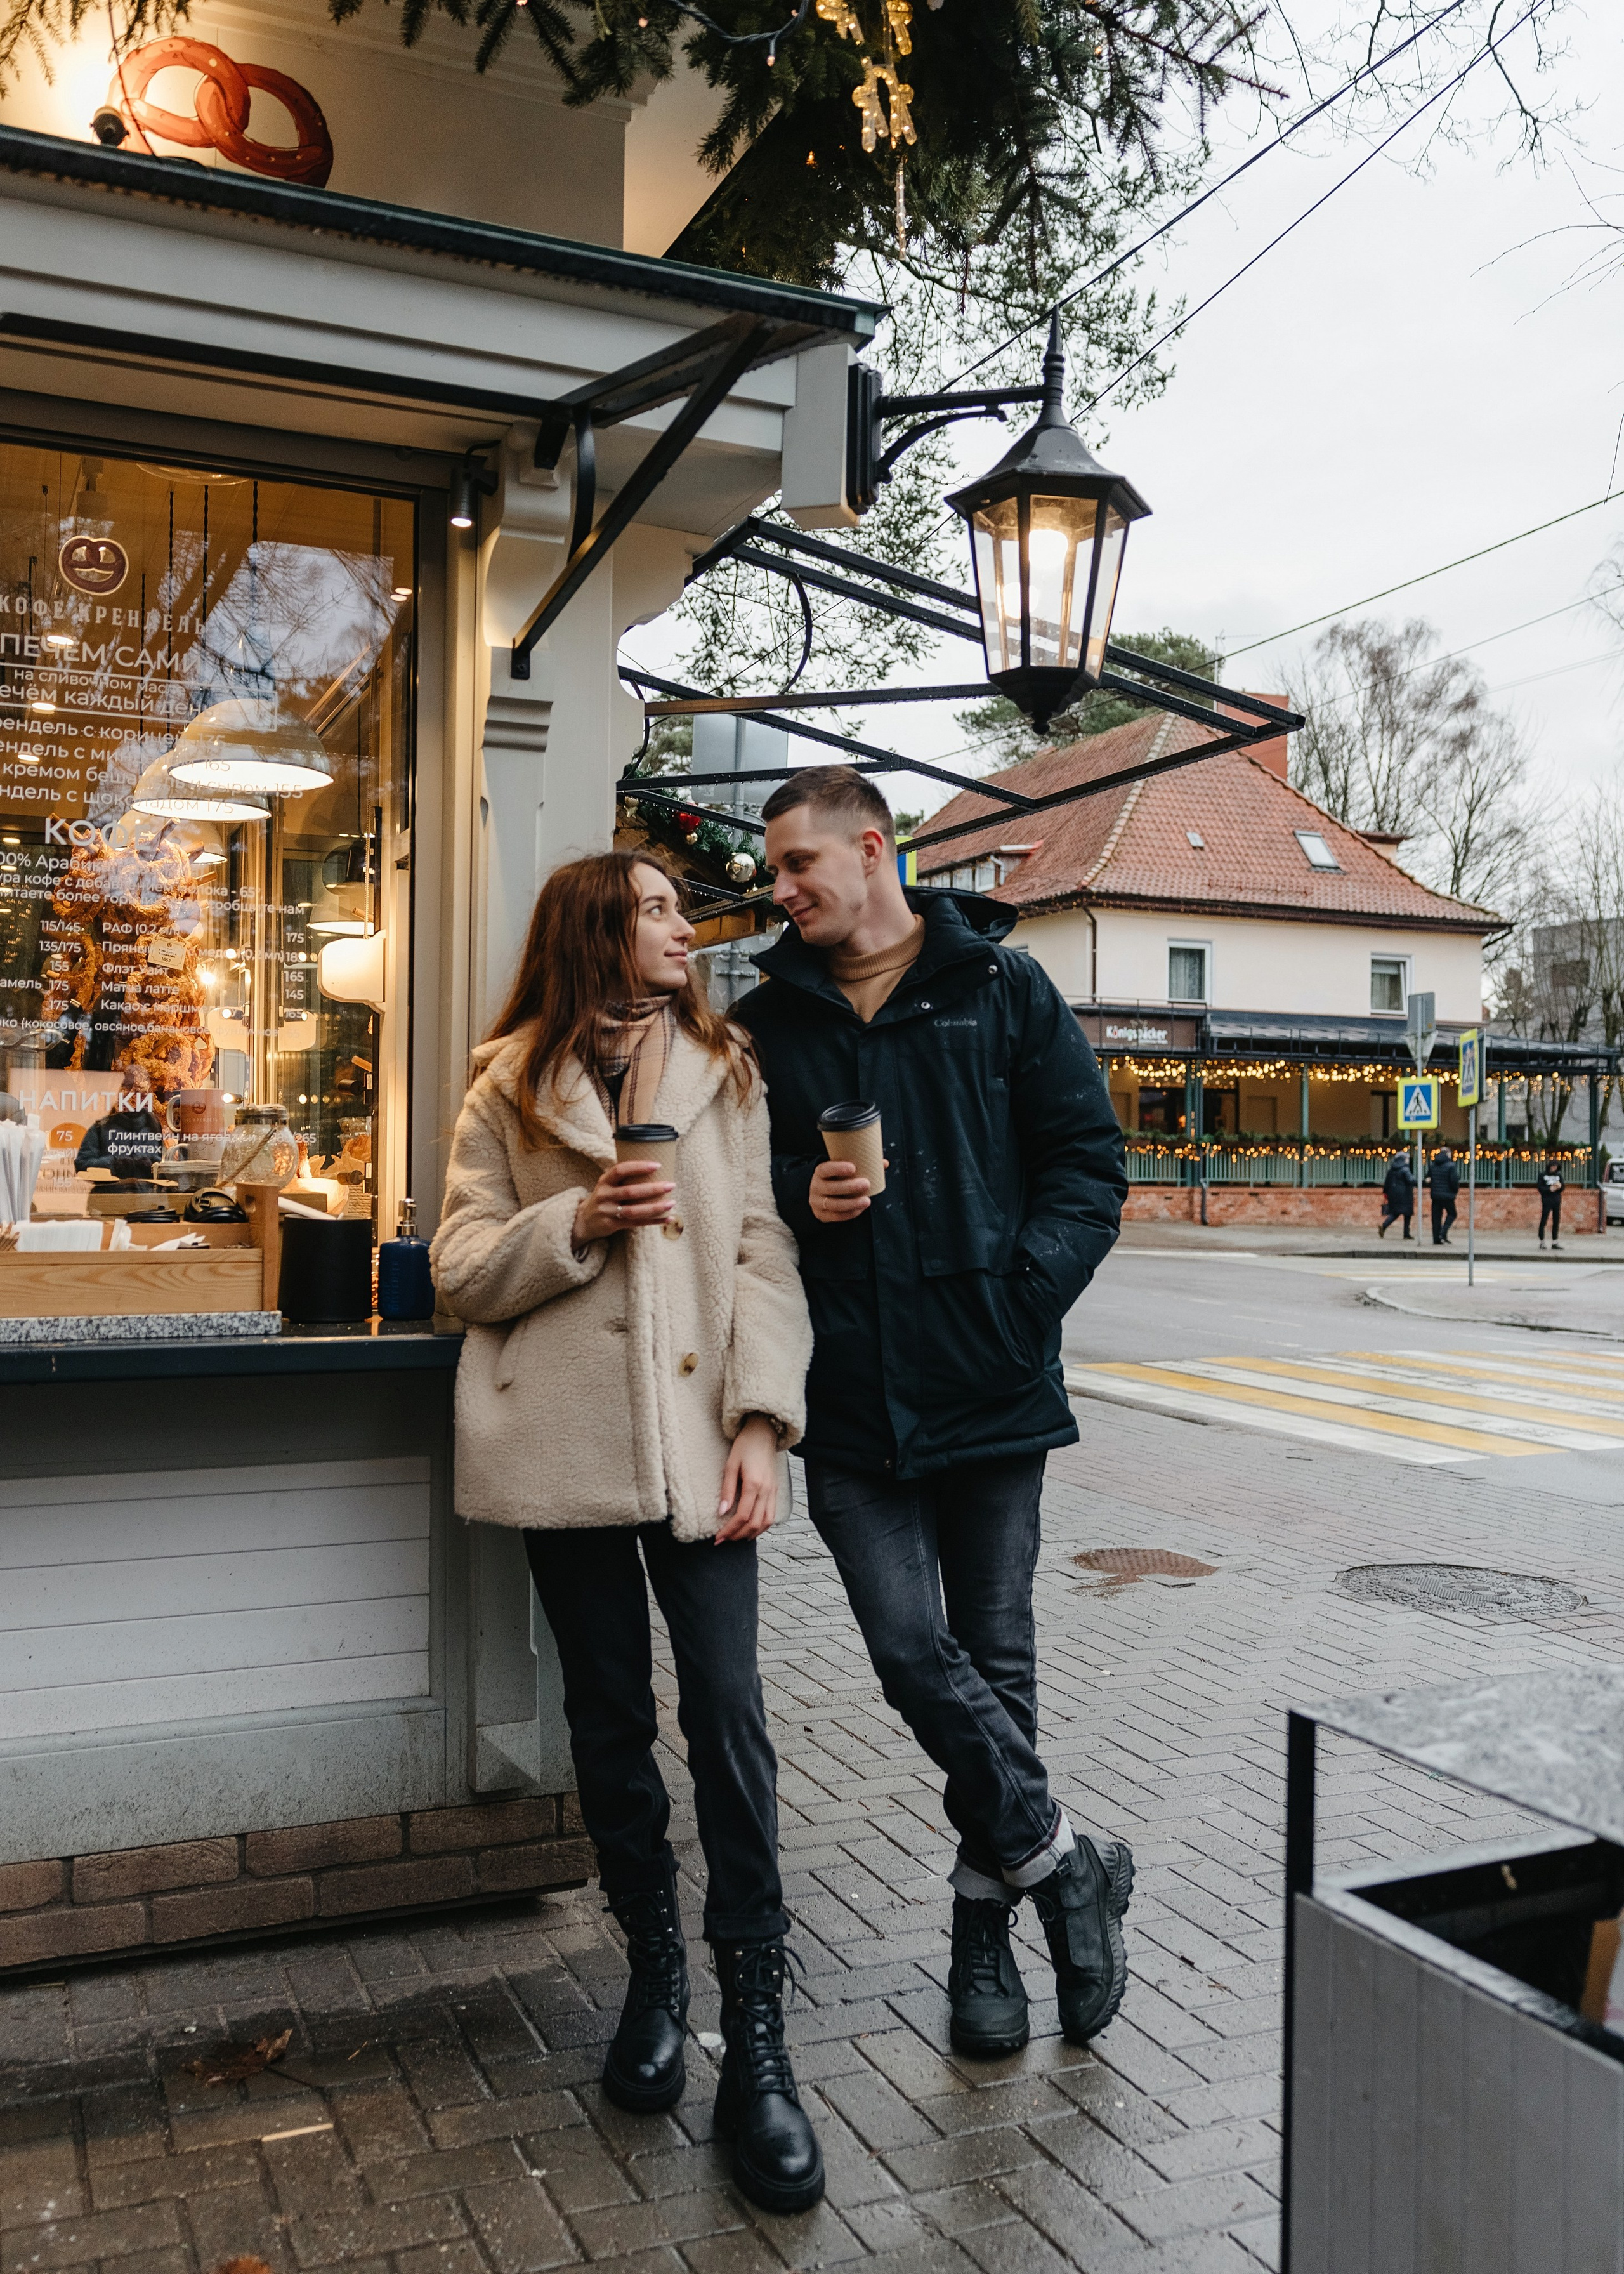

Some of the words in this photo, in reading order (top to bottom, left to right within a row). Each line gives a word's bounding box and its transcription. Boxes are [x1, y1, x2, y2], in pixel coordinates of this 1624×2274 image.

[0, 594, 65, 619] КОФЕ
[78, 602, 206, 634] КРЕНДЕЛЬ
[0, 632, 105, 663] ПЕЧЁМ
[114, 646, 202, 673] САМИ
[14, 669, 34, 681] на
[39, 671, 131, 690] сливочном
[64, 690, 154, 713] каждый
[0, 718, 78, 737] ендель
[83, 725, 94, 737] с
[74, 747, 86, 759] с
[3, 763, 80, 780] кремом
[207, 780, 267, 796] сыром
[274, 782, 303, 799] 155
[66, 790, 77, 802] с
[206, 798, 233, 814] 175
[44, 817, 152, 851] КОФЕ
[24, 873, 62, 887] кофе
[64, 877, 74, 886] с
[56, 888, 100, 903] более
[209, 898, 276, 914] сообщте
[278, 904, 305, 915] нам
[40, 920, 81, 933] 115/145
[102, 922, 133, 935] РАФ
[285, 932, 306, 943] 175
[39, 940, 81, 953] 135/175
[102, 940, 152, 955] Пряны
[285, 952, 303, 963] 18
[50, 960, 70, 972] 155
[102, 963, 136, 974] Флэт
[284, 971, 304, 982] 165
[49, 980, 69, 992] 175
[145, 984, 180, 996] латте
[285, 989, 304, 1000] 145
[49, 999, 69, 1011] 175
[101, 999, 141, 1013] Какао
[21, 1017, 92, 1032] (кокосовое,
[19, 1090, 154, 1113] НАПИТКИ
[56, 1130, 73, 1141] 75
[183, 1132, 199, 1141] на
[107, 1142, 162, 1156] фруктах
[53, 1177, 73, 1188] 155
